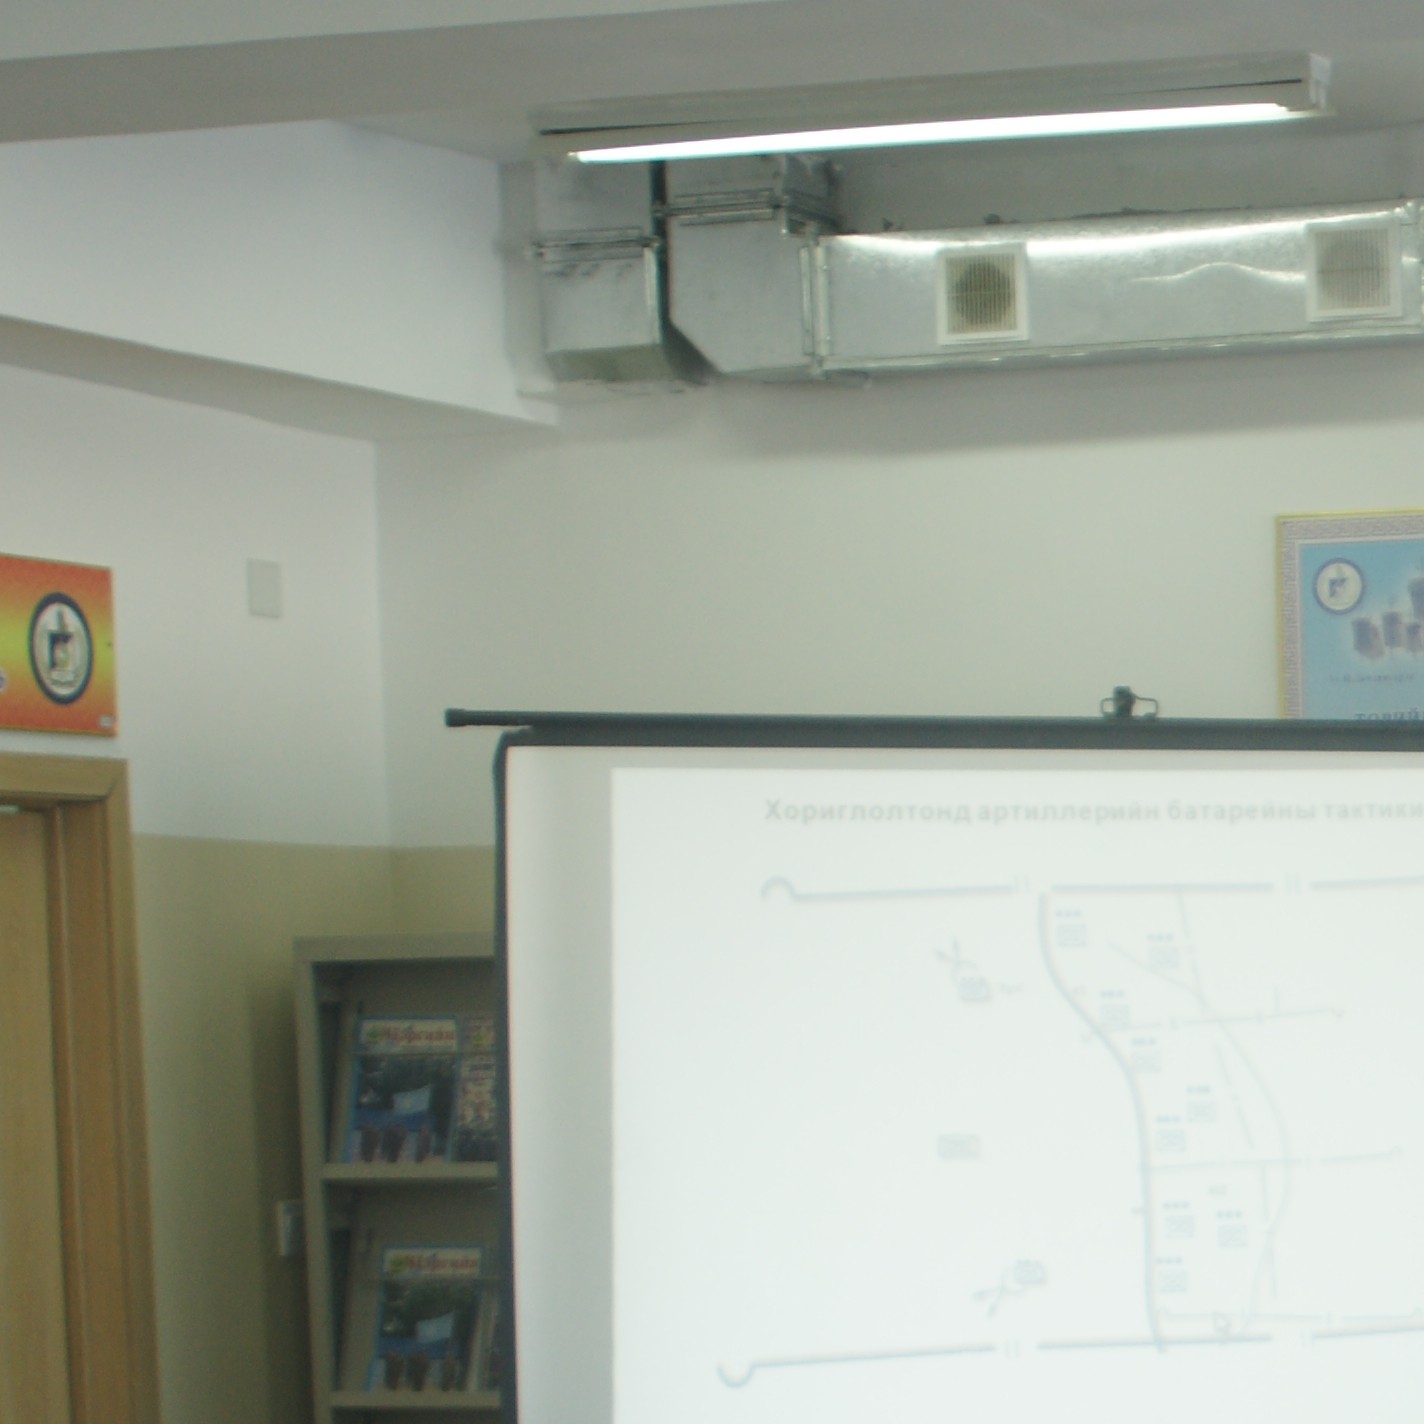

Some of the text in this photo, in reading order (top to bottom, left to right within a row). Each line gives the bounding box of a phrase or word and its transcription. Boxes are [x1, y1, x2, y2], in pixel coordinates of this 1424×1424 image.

[764, 798, 971, 824] Хориглолтонд
[977, 800, 1159, 825] артиллерийн
[1167, 799, 1316, 825] батарейны
